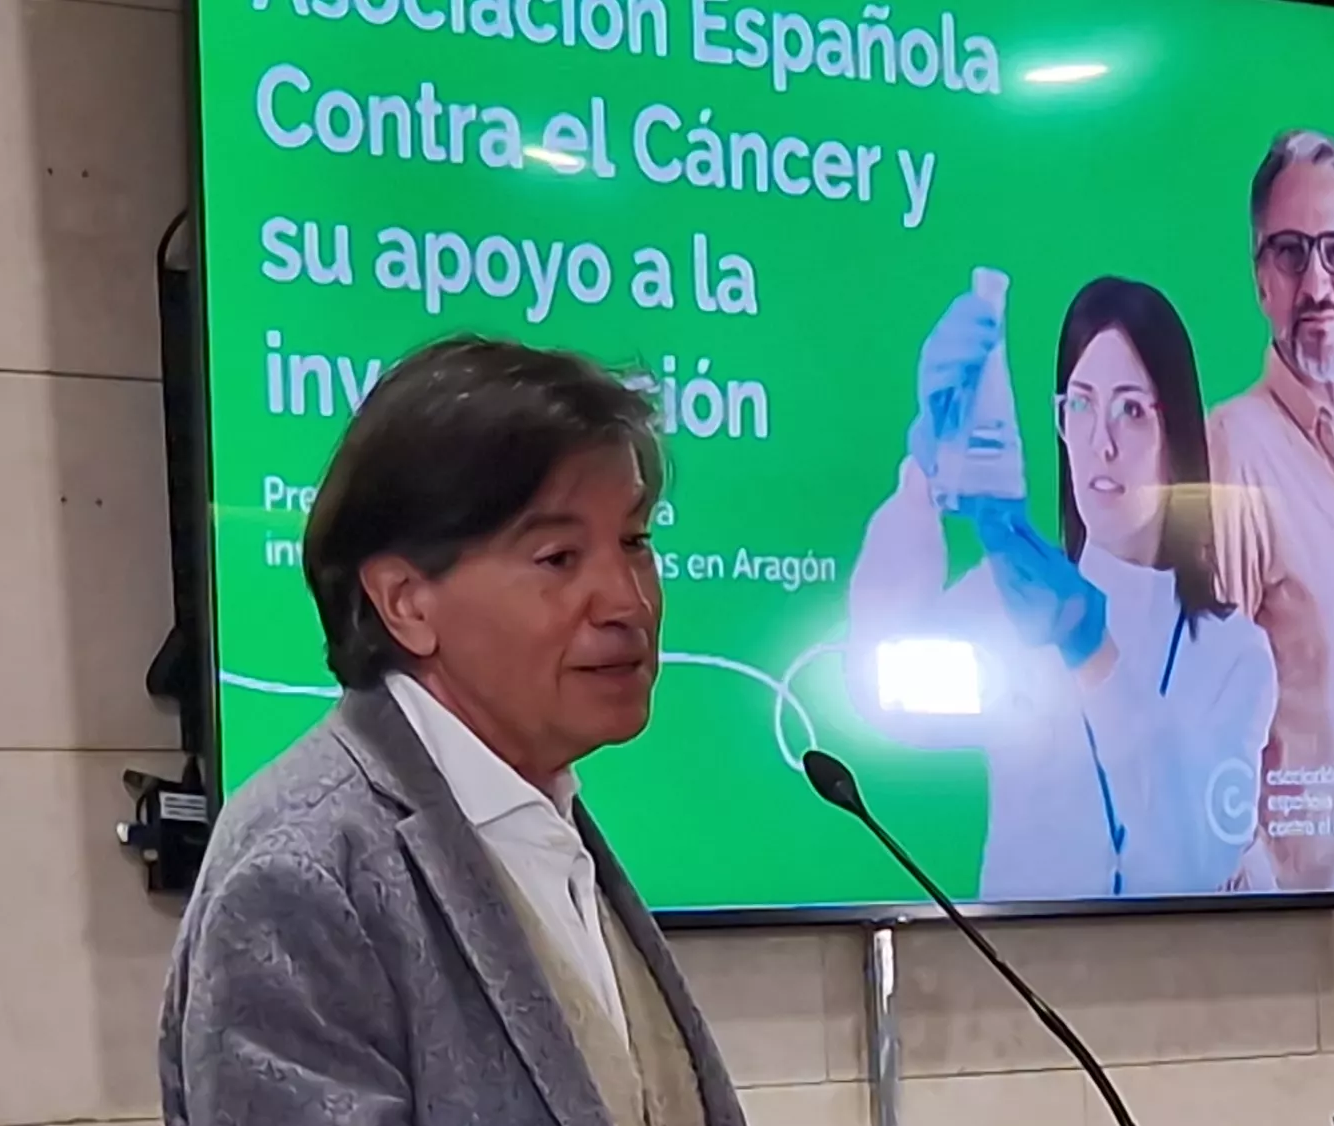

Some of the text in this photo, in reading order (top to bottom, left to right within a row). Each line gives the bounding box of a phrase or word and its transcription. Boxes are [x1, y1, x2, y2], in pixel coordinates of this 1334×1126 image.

[692, 0, 1002, 94] Española
[256, 63, 935, 228] Contra el Cáncer y
[261, 216, 758, 324] su apoyo a la
[687, 554, 724, 580] en
[732, 547, 836, 592] Aragón
